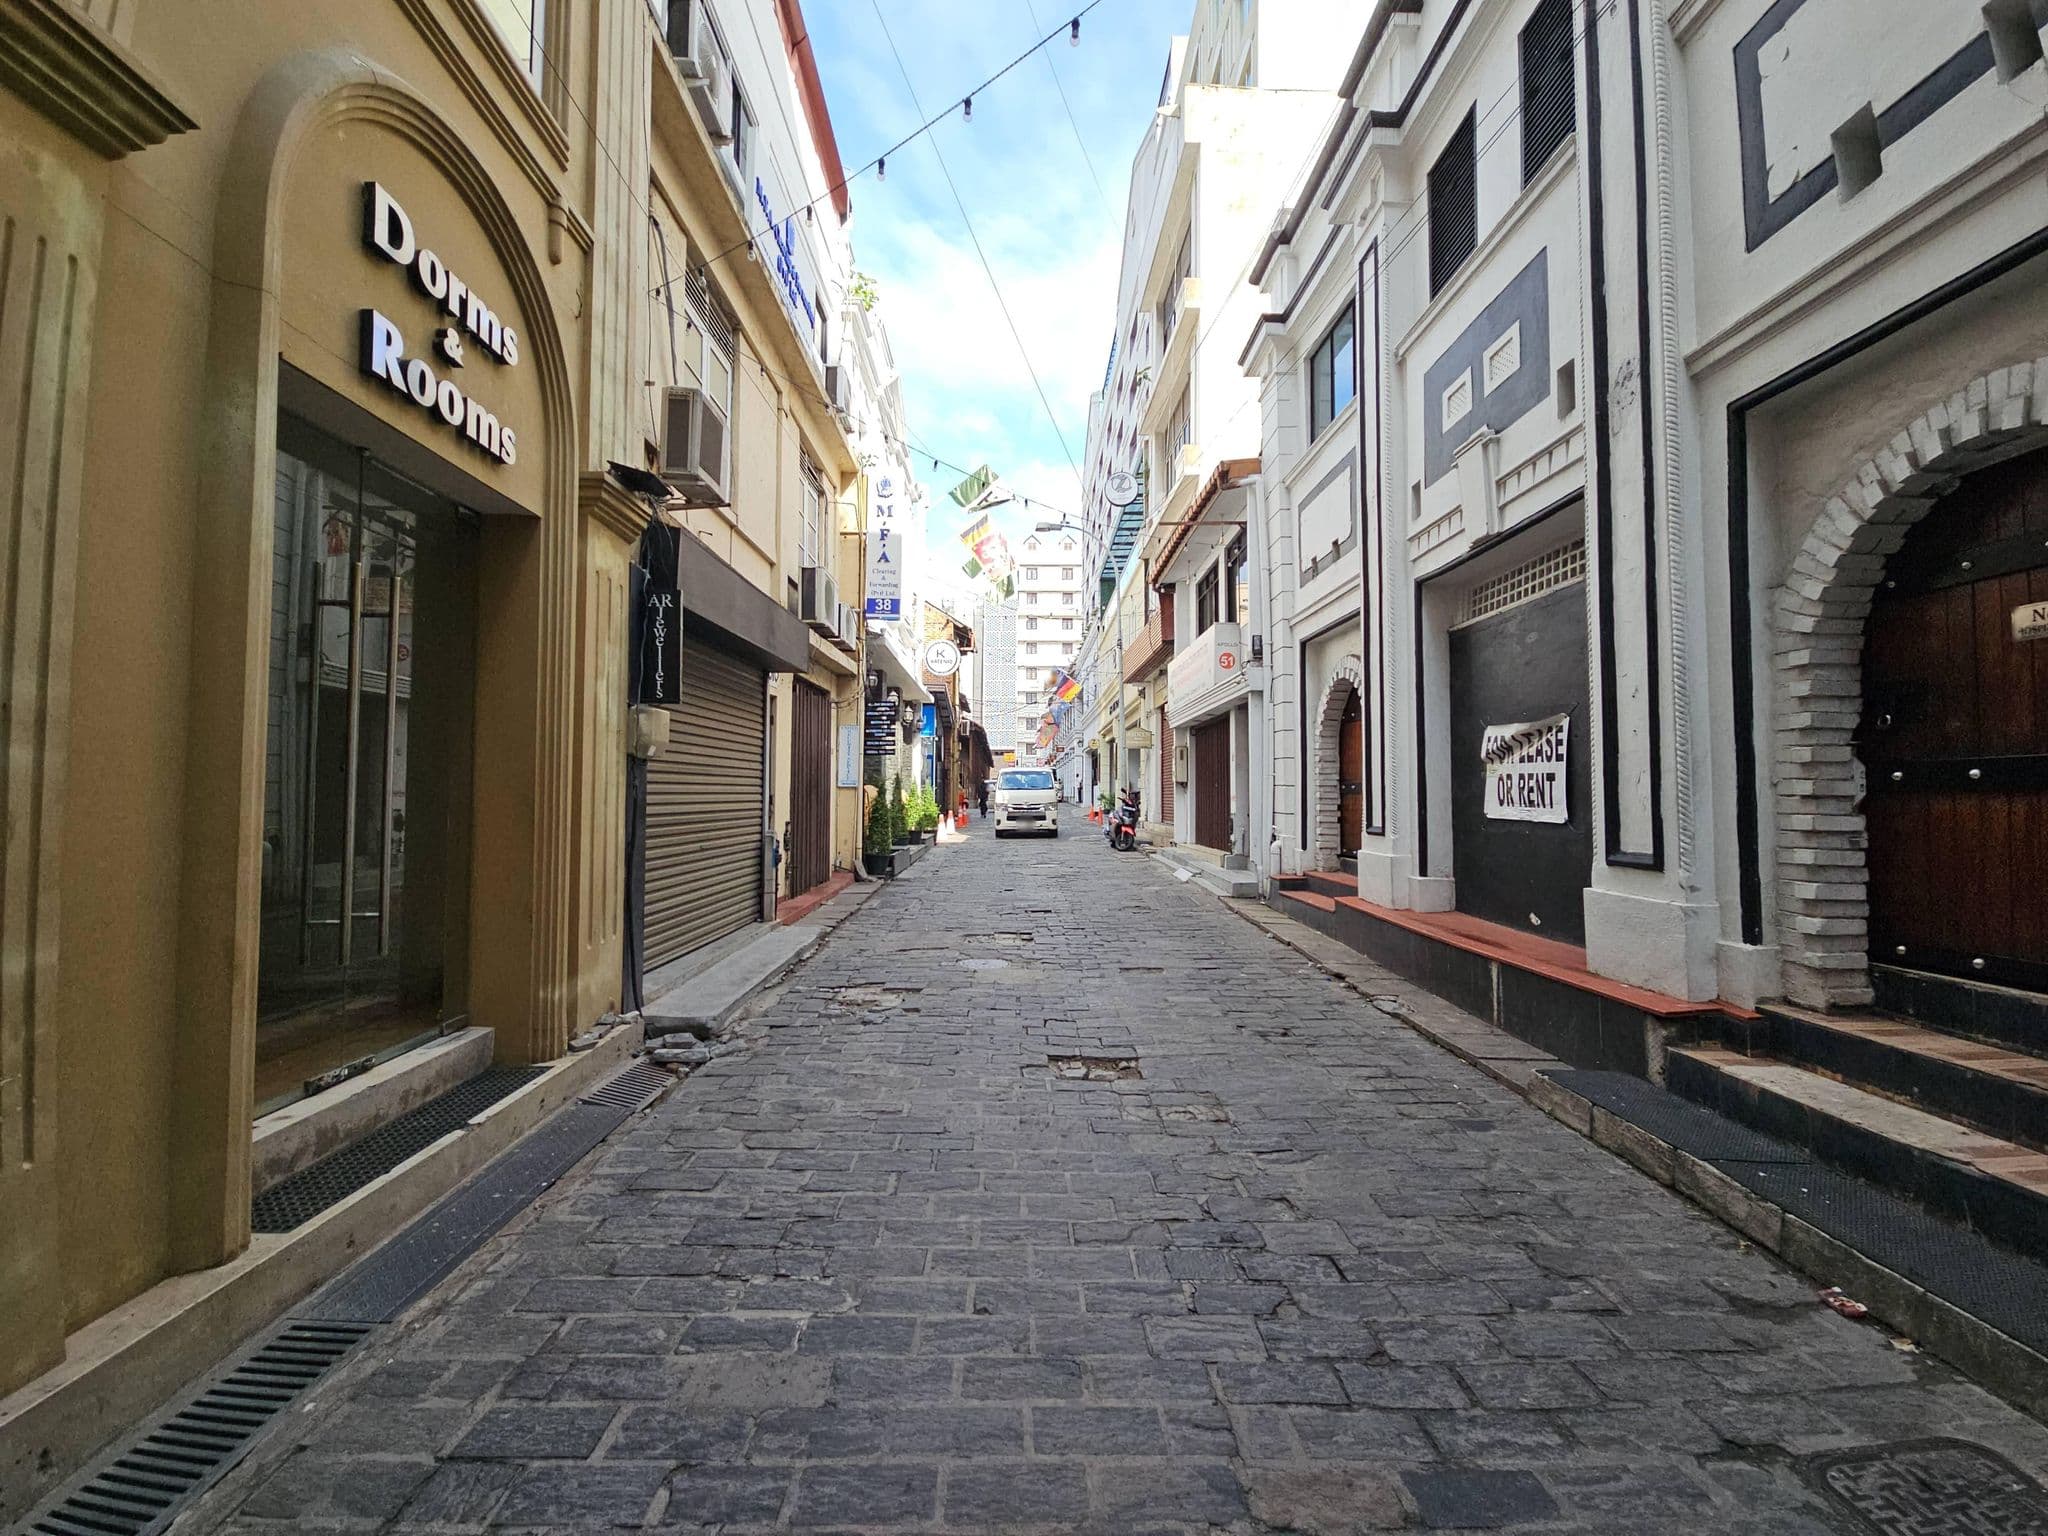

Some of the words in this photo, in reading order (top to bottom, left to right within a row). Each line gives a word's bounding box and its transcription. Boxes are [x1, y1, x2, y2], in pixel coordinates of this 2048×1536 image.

[368, 181, 519, 367] Dorms
[441, 327, 464, 368] &
[365, 309, 517, 465] Rooms
[648, 594, 673, 608] AR
[875, 599, 892, 611] 38
[936, 649, 945, 658] K
[1220, 655, 1234, 667] 51
[1486, 734, 1513, 764] FOR
[1511, 724, 1564, 764] LEASE
[1497, 774, 1514, 807] OR
[1518, 772, 1555, 808] RENT
